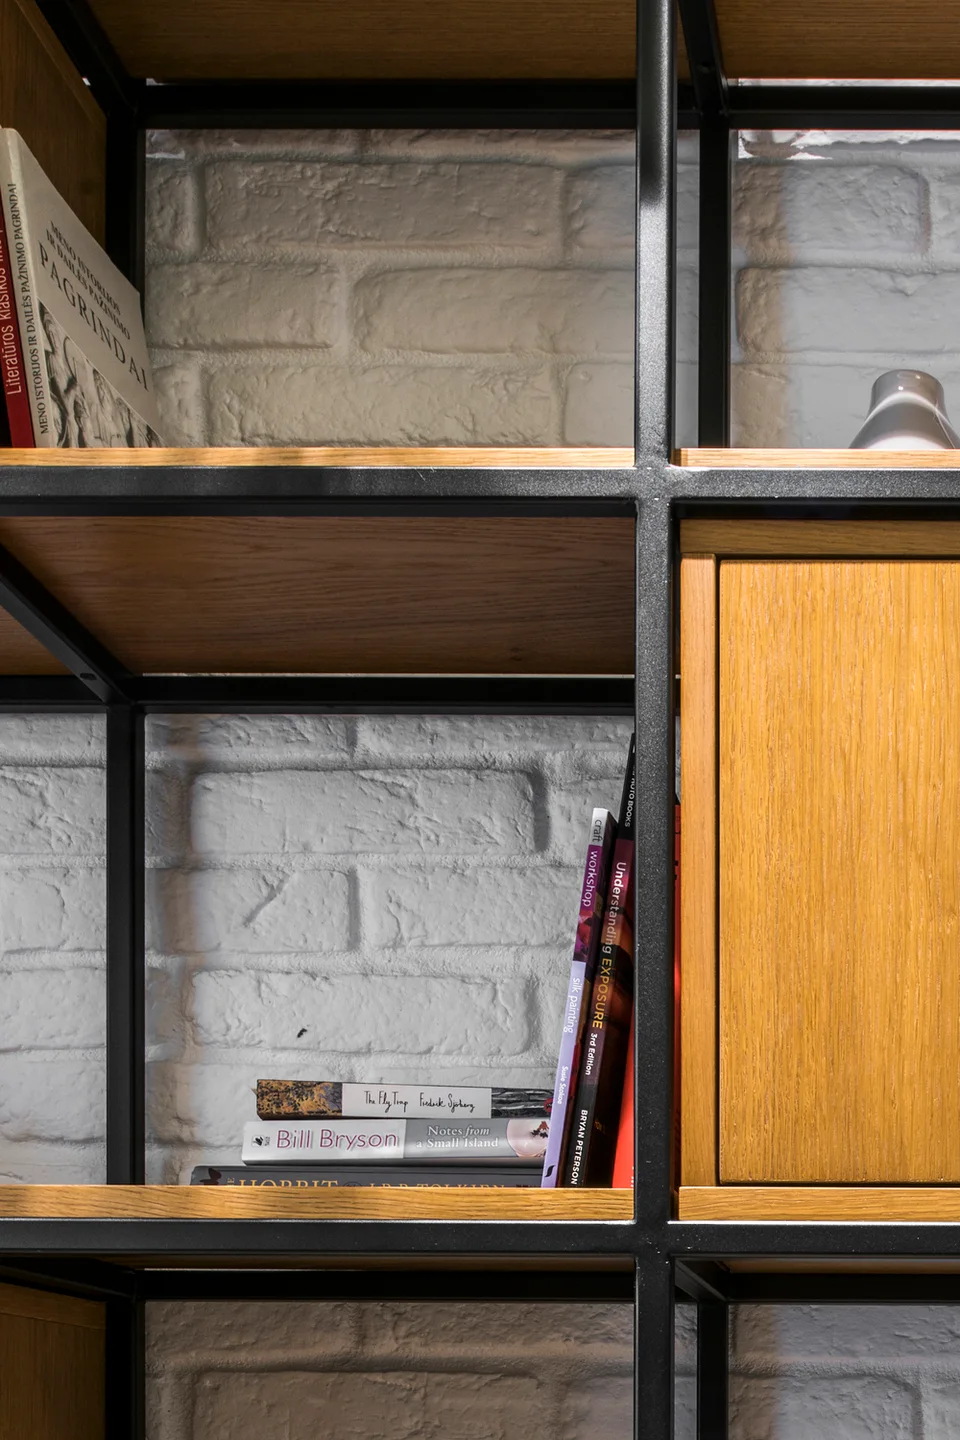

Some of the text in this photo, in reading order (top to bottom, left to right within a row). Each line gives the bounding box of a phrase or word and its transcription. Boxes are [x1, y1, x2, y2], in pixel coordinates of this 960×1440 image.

[46, 229, 56, 250] IR
[50, 220, 121, 316] MENO ISTORIJOS
[8, 184, 48, 434] MENO ISTORIJOS IR DAILĖS PAŽINIMO PAGRINDAI
[38, 240, 149, 392] PAGRINDAI
[2, 324, 22, 394] Literatūros
[592, 819, 603, 842] craft
[583, 850, 598, 907] workshop
[592, 862, 627, 1029] Understanding EXPOSURE
[564, 978, 581, 1034] silk painting
[585, 1032, 598, 1076] 3rd Edition
[364, 1090, 376, 1104] The
[378, 1091, 392, 1113] Fly
[392, 1091, 408, 1112] Trap
[420, 1092, 446, 1108] Fredrik
[276, 1130, 311, 1148] Bill
[320, 1129, 397, 1150] Bryson
[426, 1138, 458, 1148] Small
[464, 1138, 498, 1148] Island
[428, 1126, 490, 1136] Notes from
[570, 1110, 589, 1186] BRYAN PETERSON
